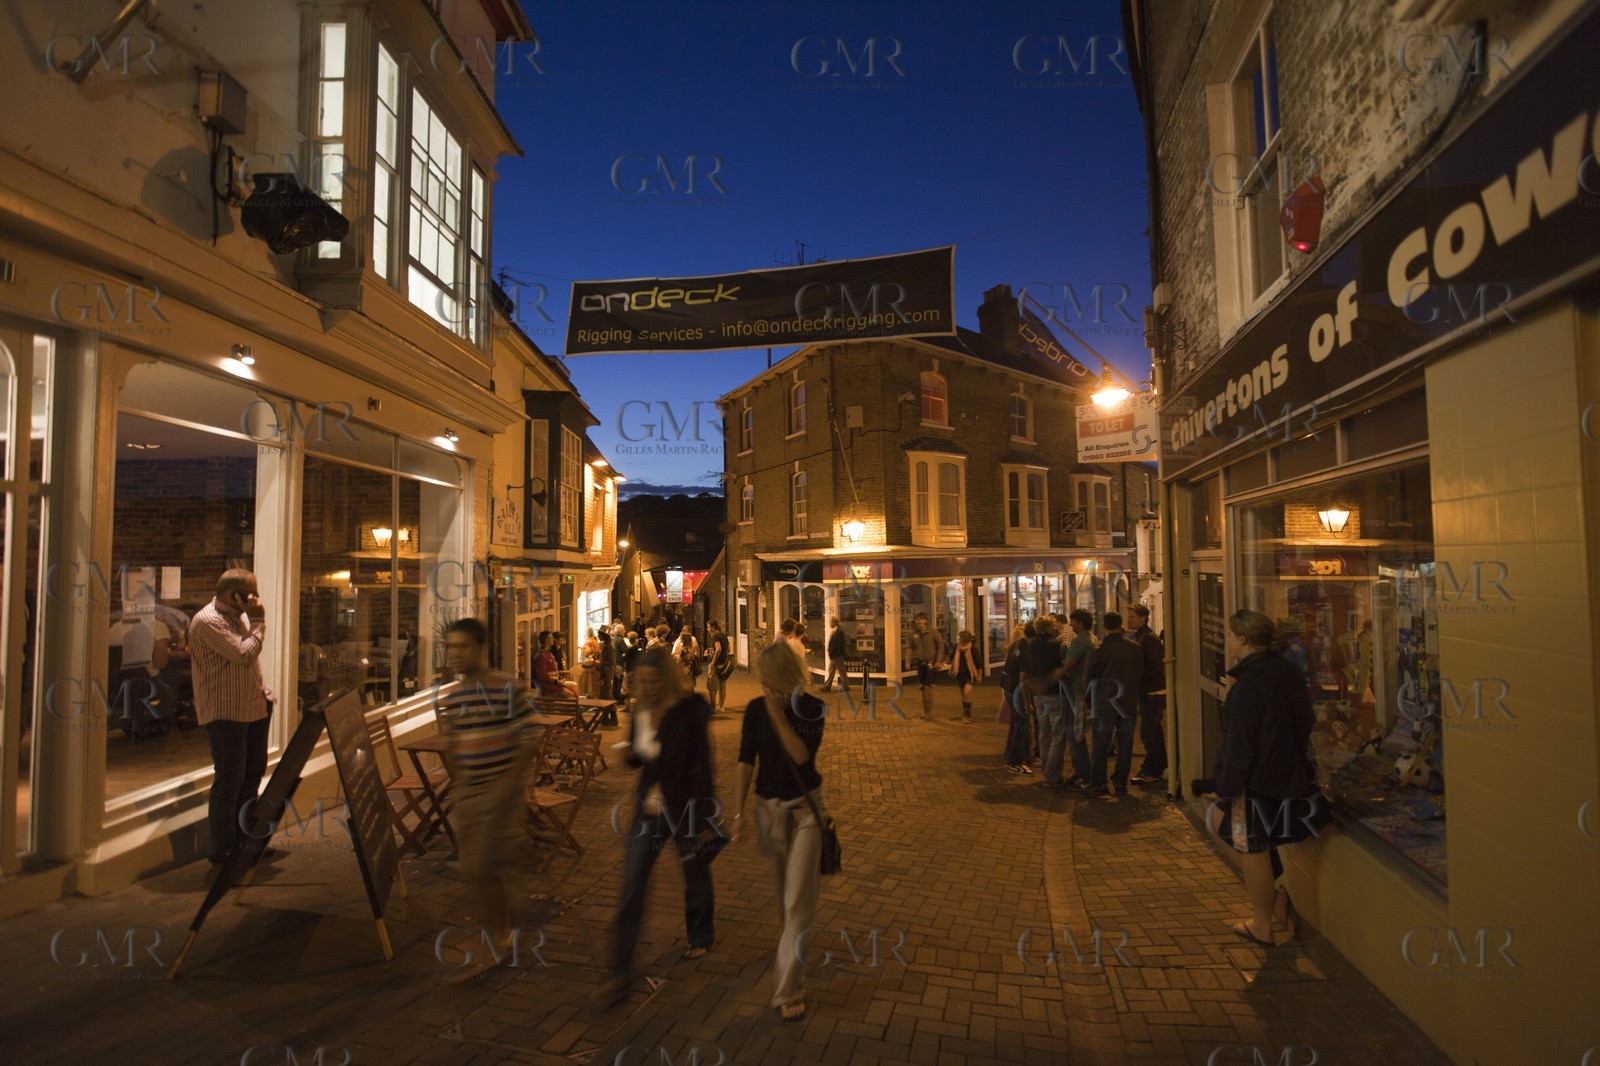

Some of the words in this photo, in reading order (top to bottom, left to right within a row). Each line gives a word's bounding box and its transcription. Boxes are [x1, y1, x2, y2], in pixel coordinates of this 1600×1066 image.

[579, 283, 741, 314] ondeck
[577, 328, 632, 344] Rigging
[639, 324, 704, 341] Services
[721, 307, 940, 338] info@ondeckrigging.com
[1308, 280, 1359, 363] of
[1089, 422, 1104, 434] TO
[1105, 418, 1125, 432] LET
[1095, 441, 1130, 451] Enquiries
